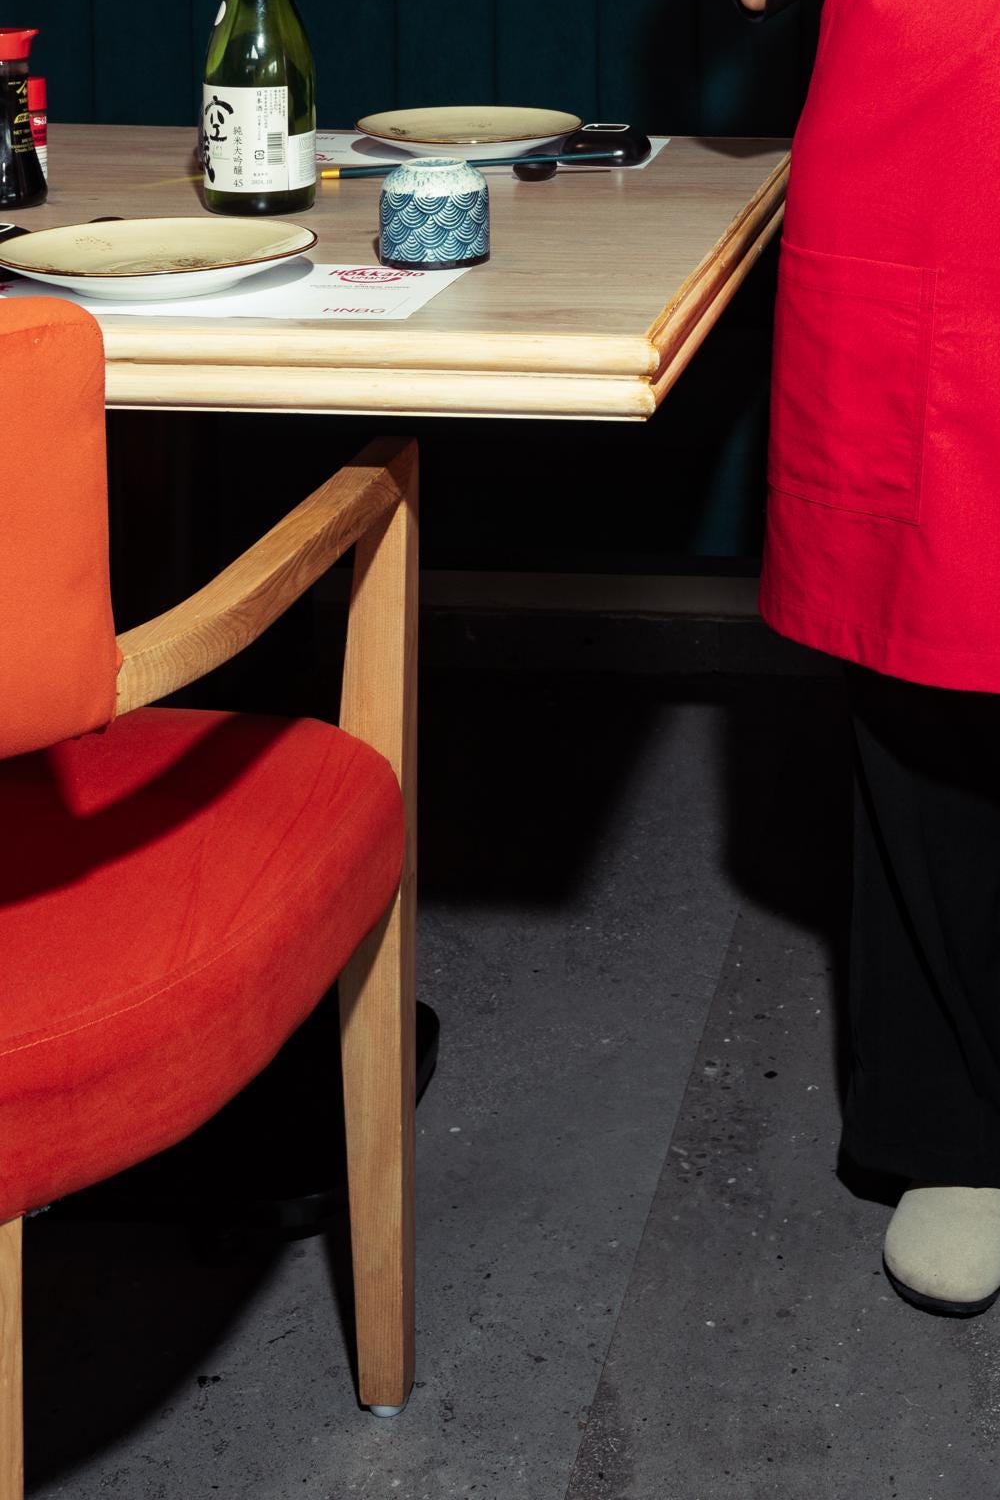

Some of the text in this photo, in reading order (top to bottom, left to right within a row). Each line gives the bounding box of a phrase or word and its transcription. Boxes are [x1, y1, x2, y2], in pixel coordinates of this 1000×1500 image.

[232, 126, 244, 175] 純米大吟醸
[233, 179, 244, 187] 45
[328, 268, 426, 278] Hokkaido
